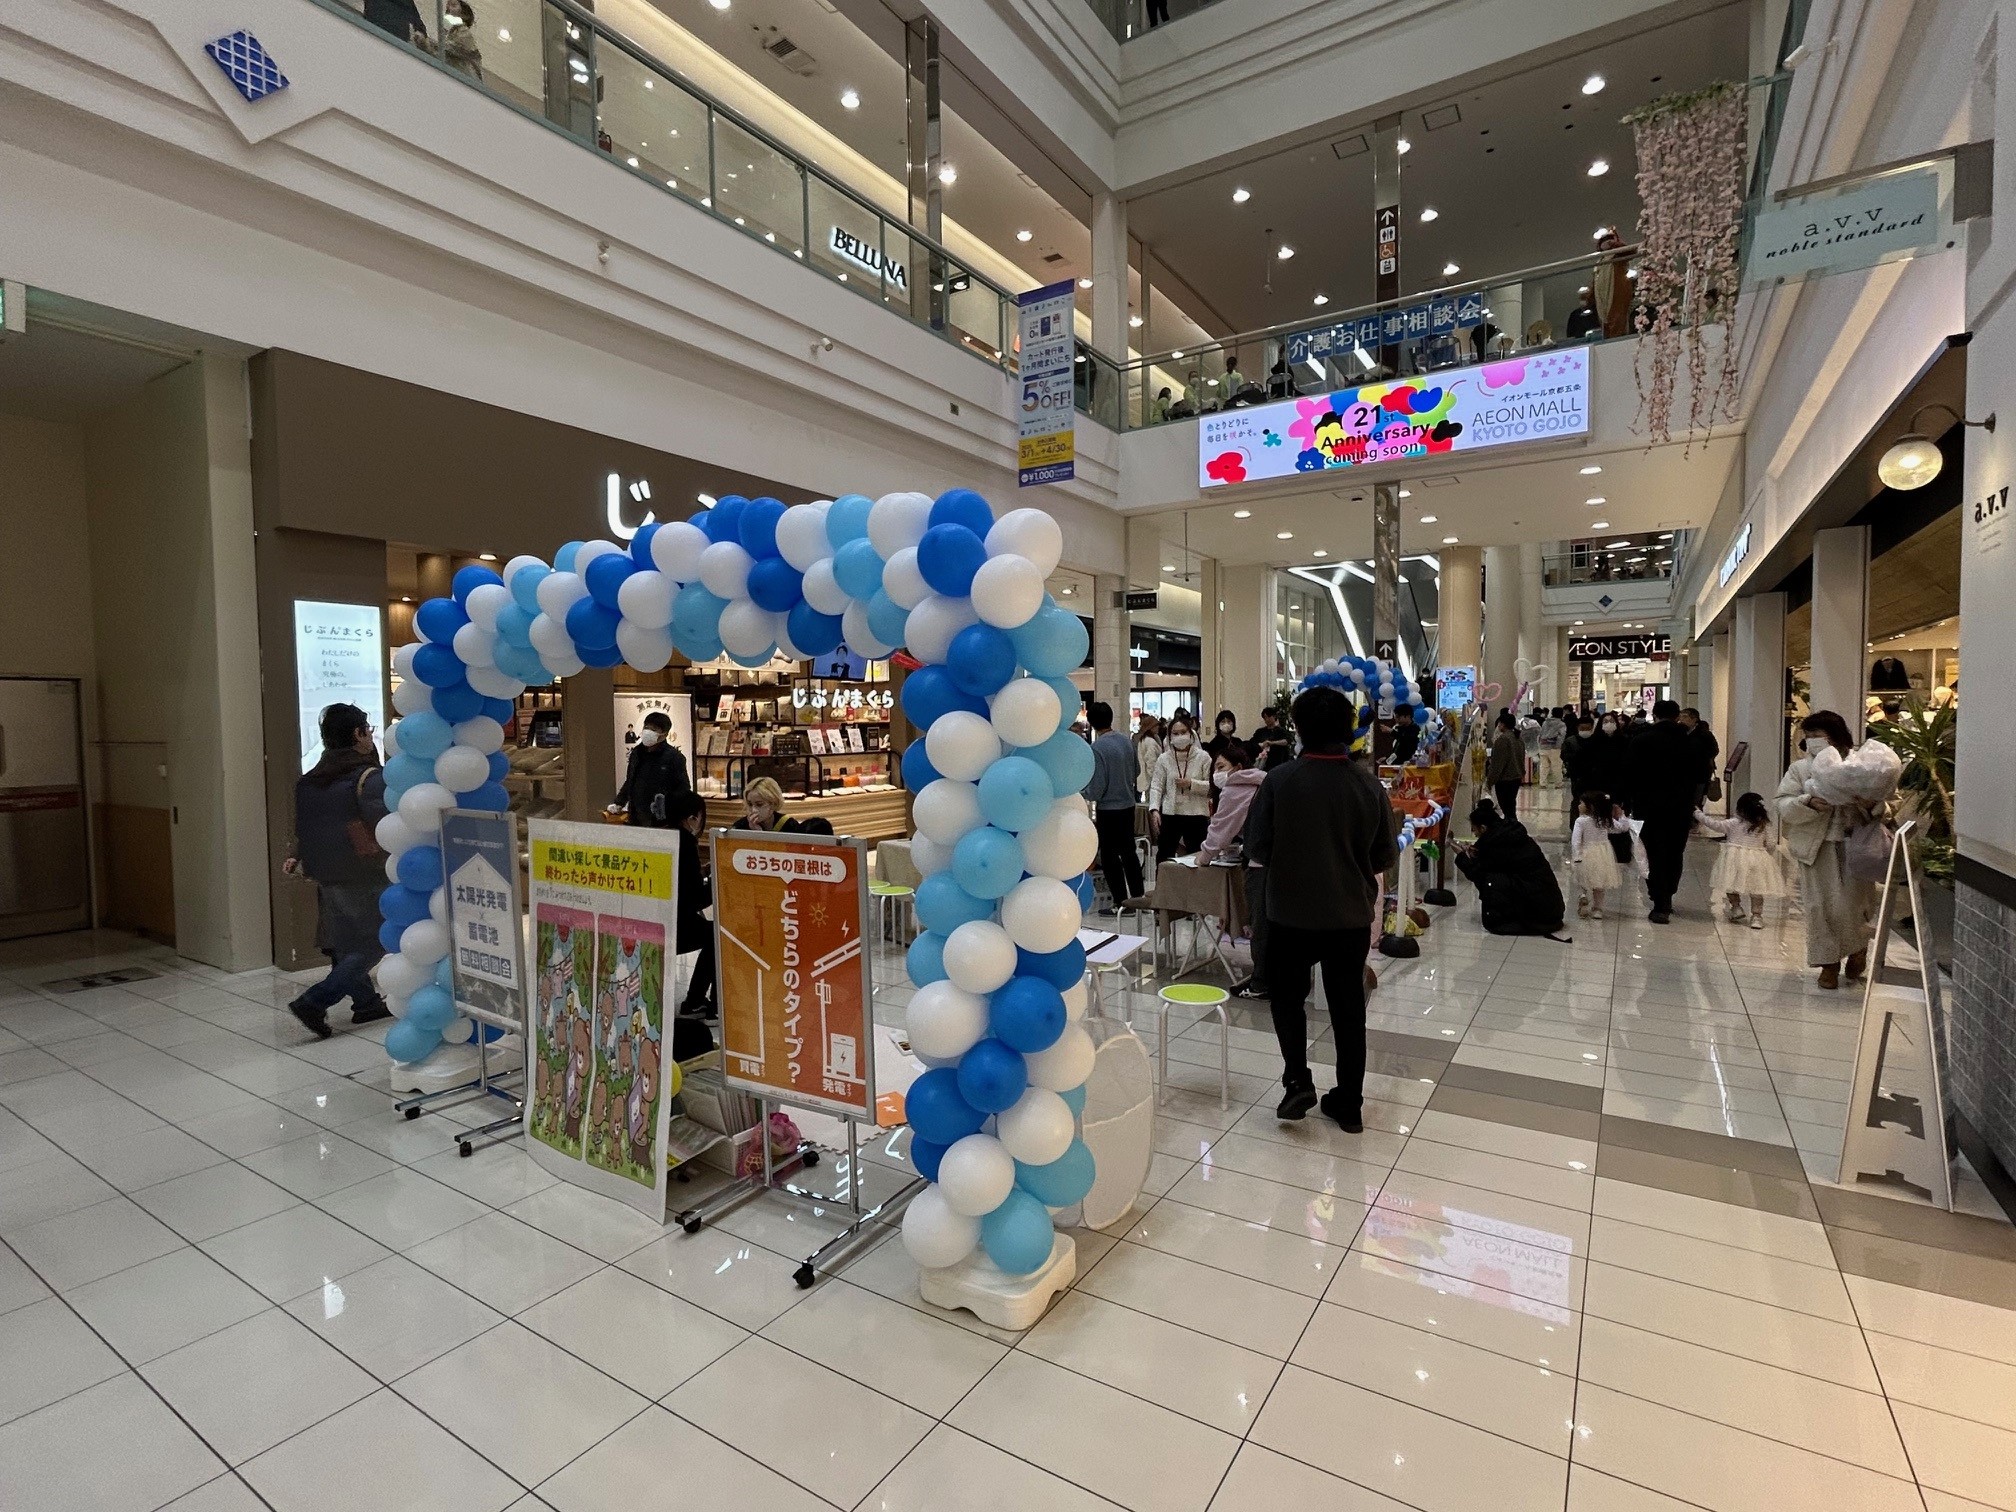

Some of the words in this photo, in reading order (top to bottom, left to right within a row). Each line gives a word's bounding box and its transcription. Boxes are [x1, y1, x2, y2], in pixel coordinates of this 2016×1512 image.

[1804, 207, 1883, 236] a.v.v
[1766, 240, 1818, 259] noble
[1825, 213, 1925, 246] standard
[833, 227, 907, 287] BELLUNA
[1290, 299, 1481, 359] 介護お仕事相談会
[1501, 383, 1582, 403] イオンモール京都五条
[1206, 417, 1250, 432] 色とりどりに
[1353, 404, 1395, 428] 21st
[1472, 405, 1525, 428] AEON
[1529, 397, 1582, 418] MALL
[1321, 422, 1431, 450] Anniversary
[1472, 421, 1528, 442] KYOTO
[1533, 413, 1582, 433] GOJO
[1325, 446, 1378, 465] coming
[1383, 442, 1421, 457] soon
[304, 625, 374, 638] じぶんまくら
[1617, 639, 1671, 655] STYLE
[792, 688, 895, 709] じぶんまくら
[548, 847, 650, 873] 間違い探して景品ゲット
[746, 855, 833, 877] おうちの屋根は
[456, 885, 508, 912] 太陽光発電
[468, 922, 500, 946] 蓄電池
[822, 1077, 847, 1096] 発電
